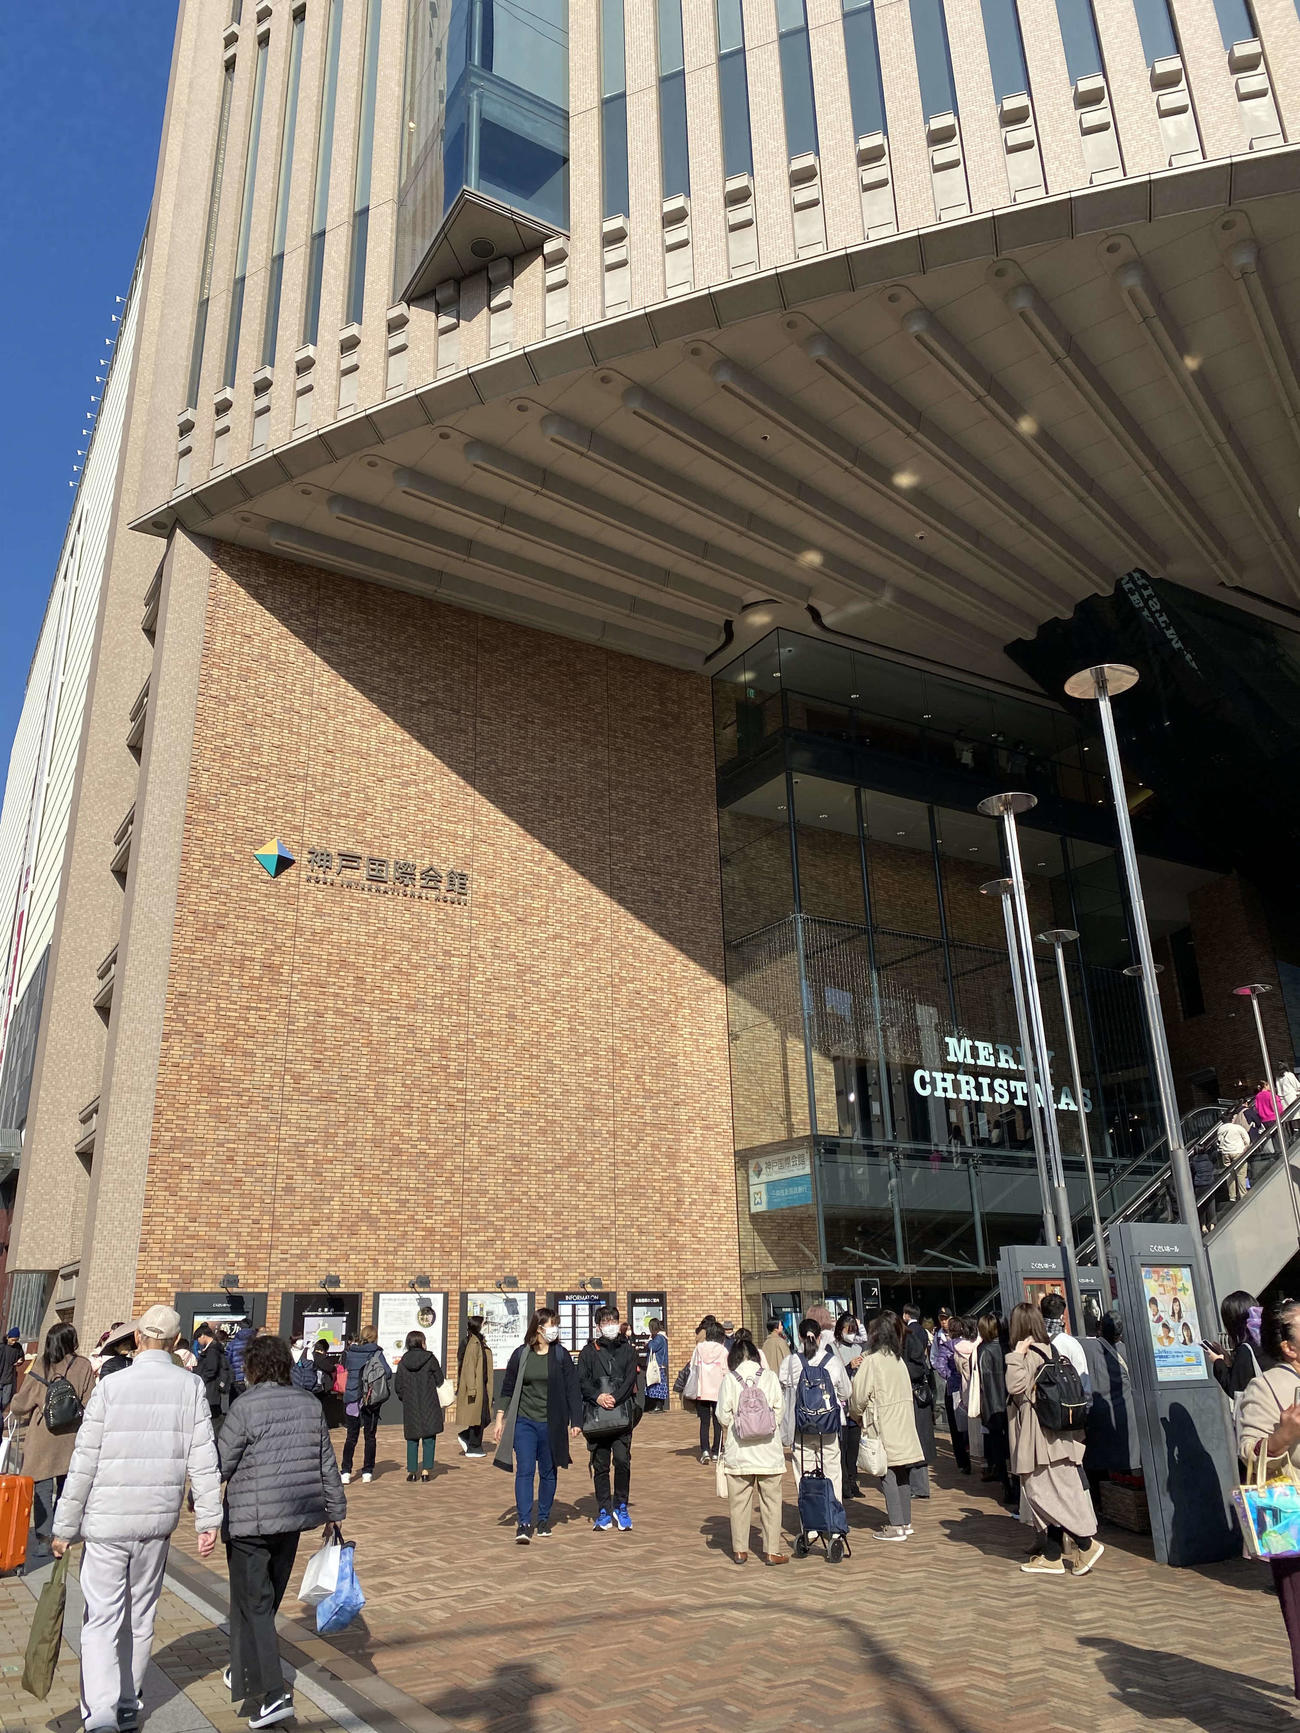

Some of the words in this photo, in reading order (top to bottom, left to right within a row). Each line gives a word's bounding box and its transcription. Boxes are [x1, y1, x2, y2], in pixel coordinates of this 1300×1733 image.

[307, 847, 469, 896] 神戸国際会館
[306, 875, 335, 887] KOBE
[340, 879, 430, 901] INTERNATIONAL
[1149, 1244, 1180, 1253] こくさいホール
[1030, 1261, 1057, 1269] こくさいホール
